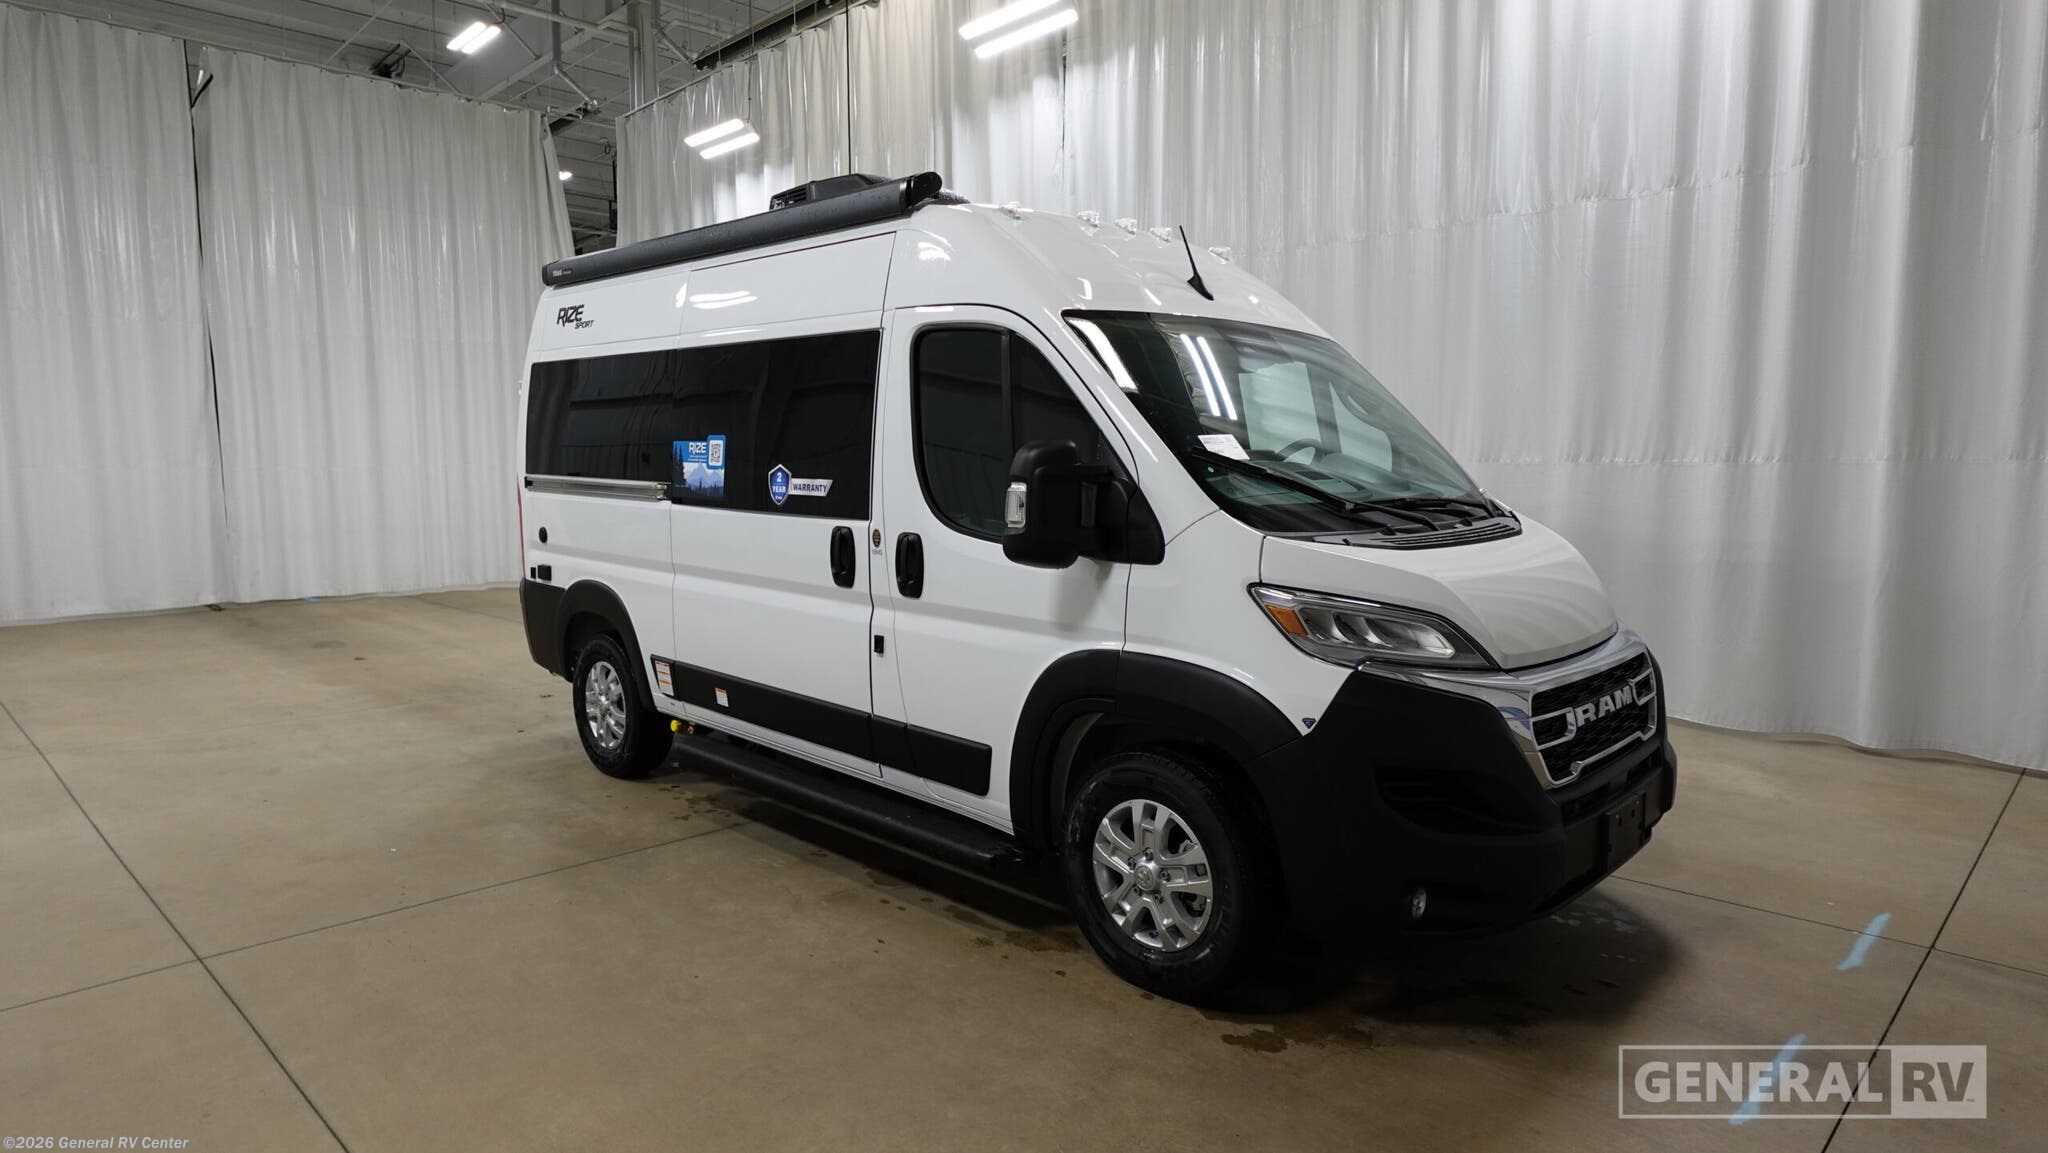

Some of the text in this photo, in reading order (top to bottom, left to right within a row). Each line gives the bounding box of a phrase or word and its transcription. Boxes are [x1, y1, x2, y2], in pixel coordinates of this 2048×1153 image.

[556, 304, 585, 327] RIZE
[574, 319, 595, 329] SPORT
[688, 442, 707, 455] RIZE
[776, 472, 783, 483] 2
[793, 483, 828, 493] WARRANTY
[1575, 685, 1633, 728] RAM
